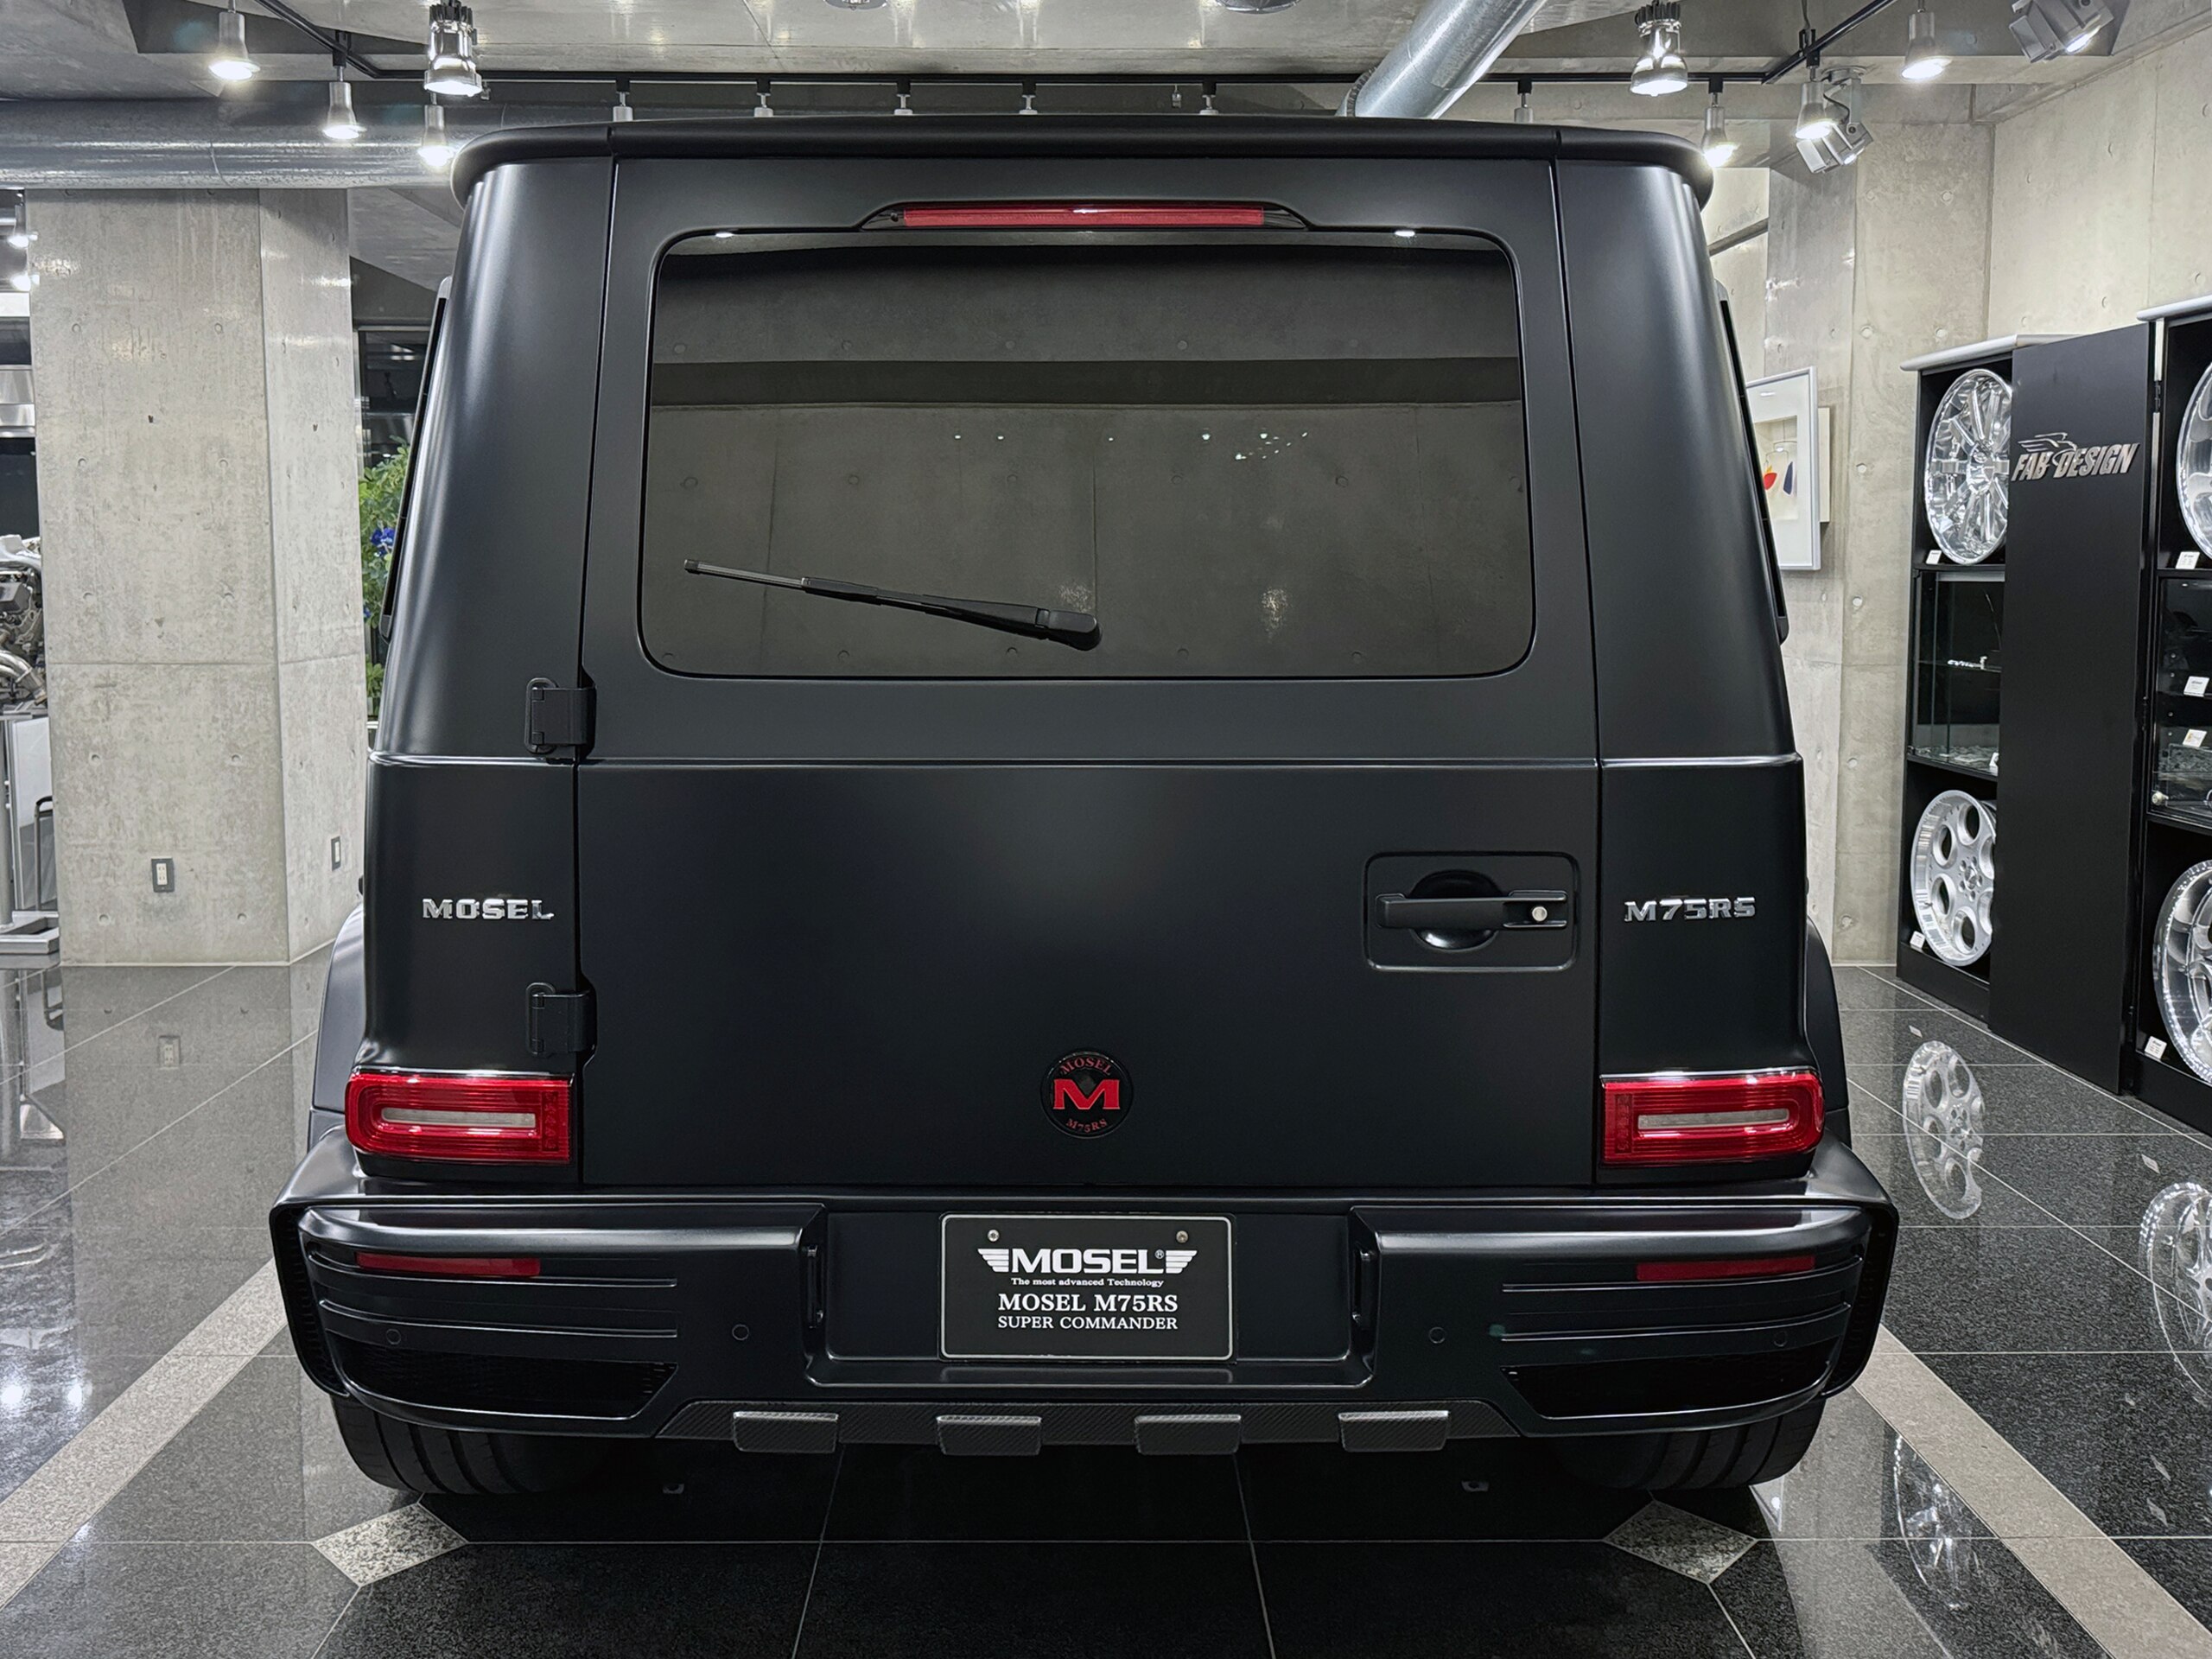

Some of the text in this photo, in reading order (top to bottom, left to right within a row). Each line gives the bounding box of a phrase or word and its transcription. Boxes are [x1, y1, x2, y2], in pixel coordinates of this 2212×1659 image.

[2010, 442, 2141, 482] FAB DESIGN
[422, 898, 555, 920] MOSEL
[1624, 896, 1756, 922] M75RS
[1059, 1056, 1112, 1077] MOSEL
[1052, 1078, 1121, 1110] M
[1065, 1117, 1108, 1134] M75RS
[1010, 1277, 1165, 1288] The most advanced Technology
[997, 1294, 1179, 1313] MOSEL M75RS
[997, 1316, 1179, 1330] SUPER COMMANDER
